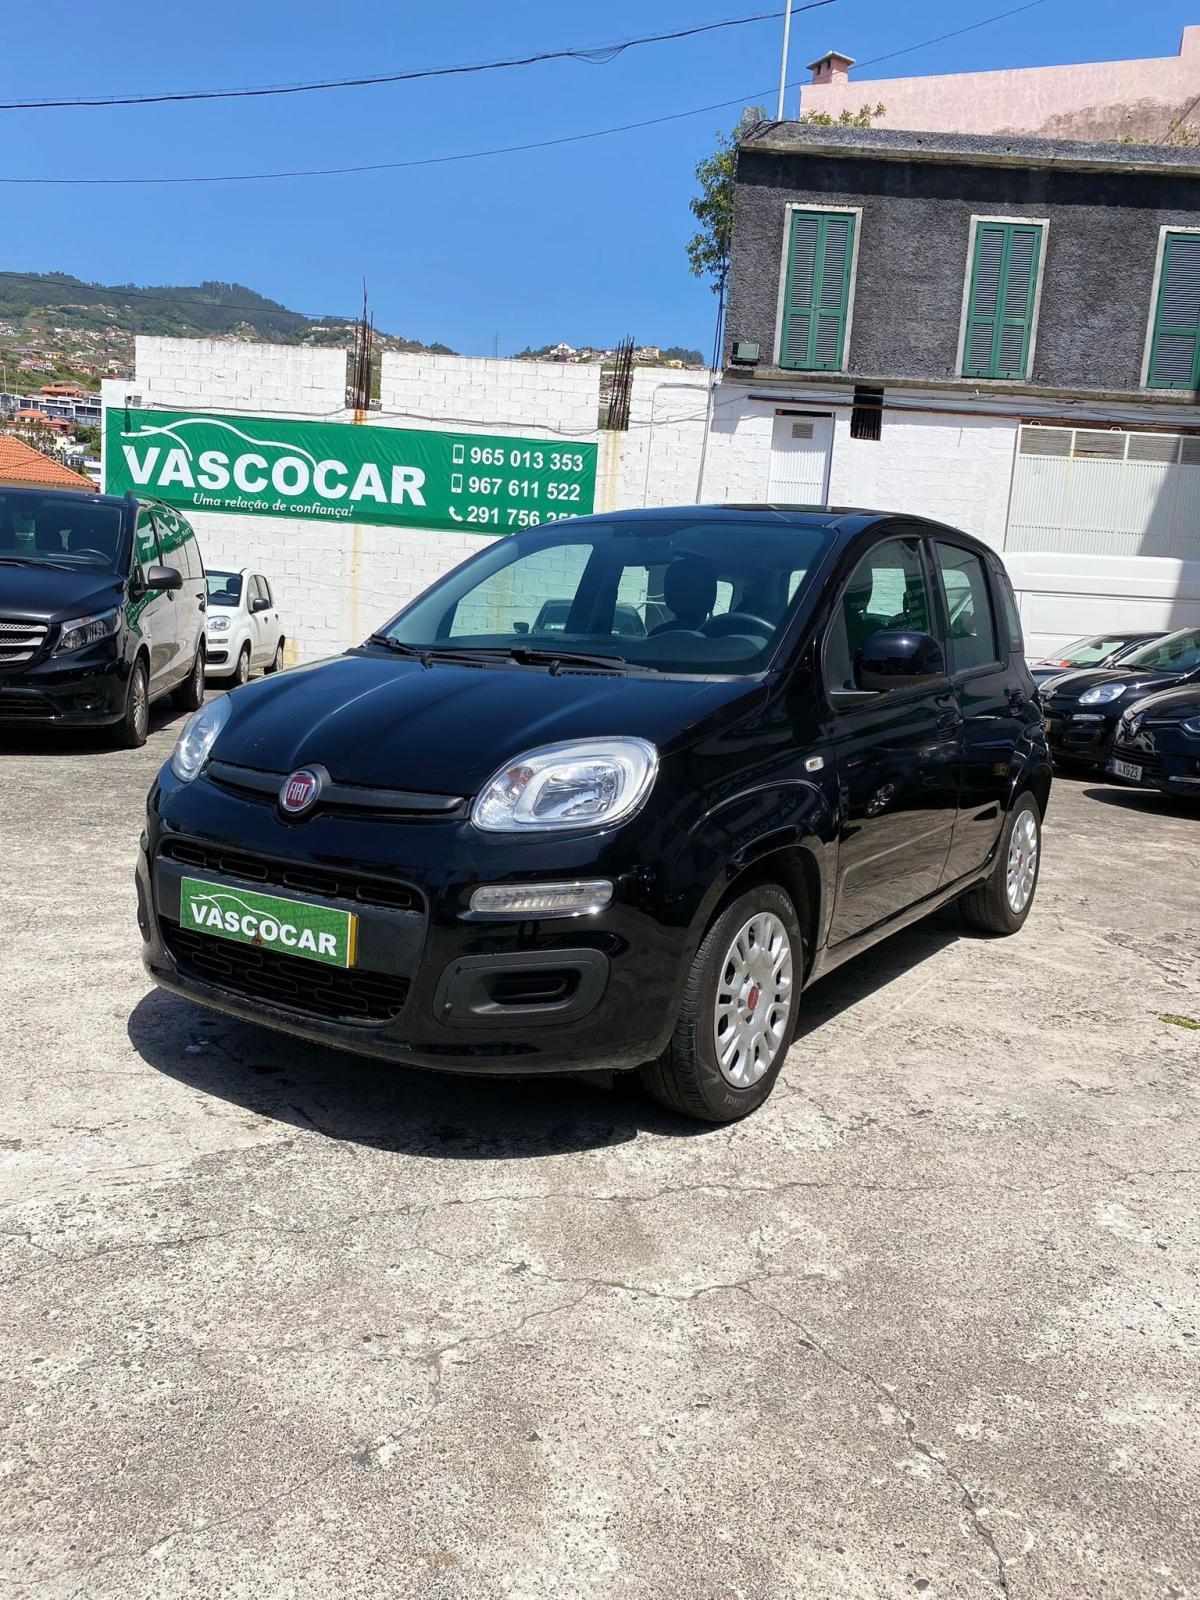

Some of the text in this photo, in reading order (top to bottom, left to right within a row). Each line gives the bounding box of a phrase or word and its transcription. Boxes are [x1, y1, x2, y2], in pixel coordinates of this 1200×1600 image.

[470, 447, 583, 472] 965 013 353
[121, 445, 426, 506] VASCOCAR
[468, 476, 580, 501] 967 611 522
[192, 492, 354, 518] Uma relação de confiança!
[466, 505, 499, 524] 291
[507, 508, 540, 527] 756
[287, 781, 310, 801] FIAT
[190, 903, 337, 957] VASCOCAR
